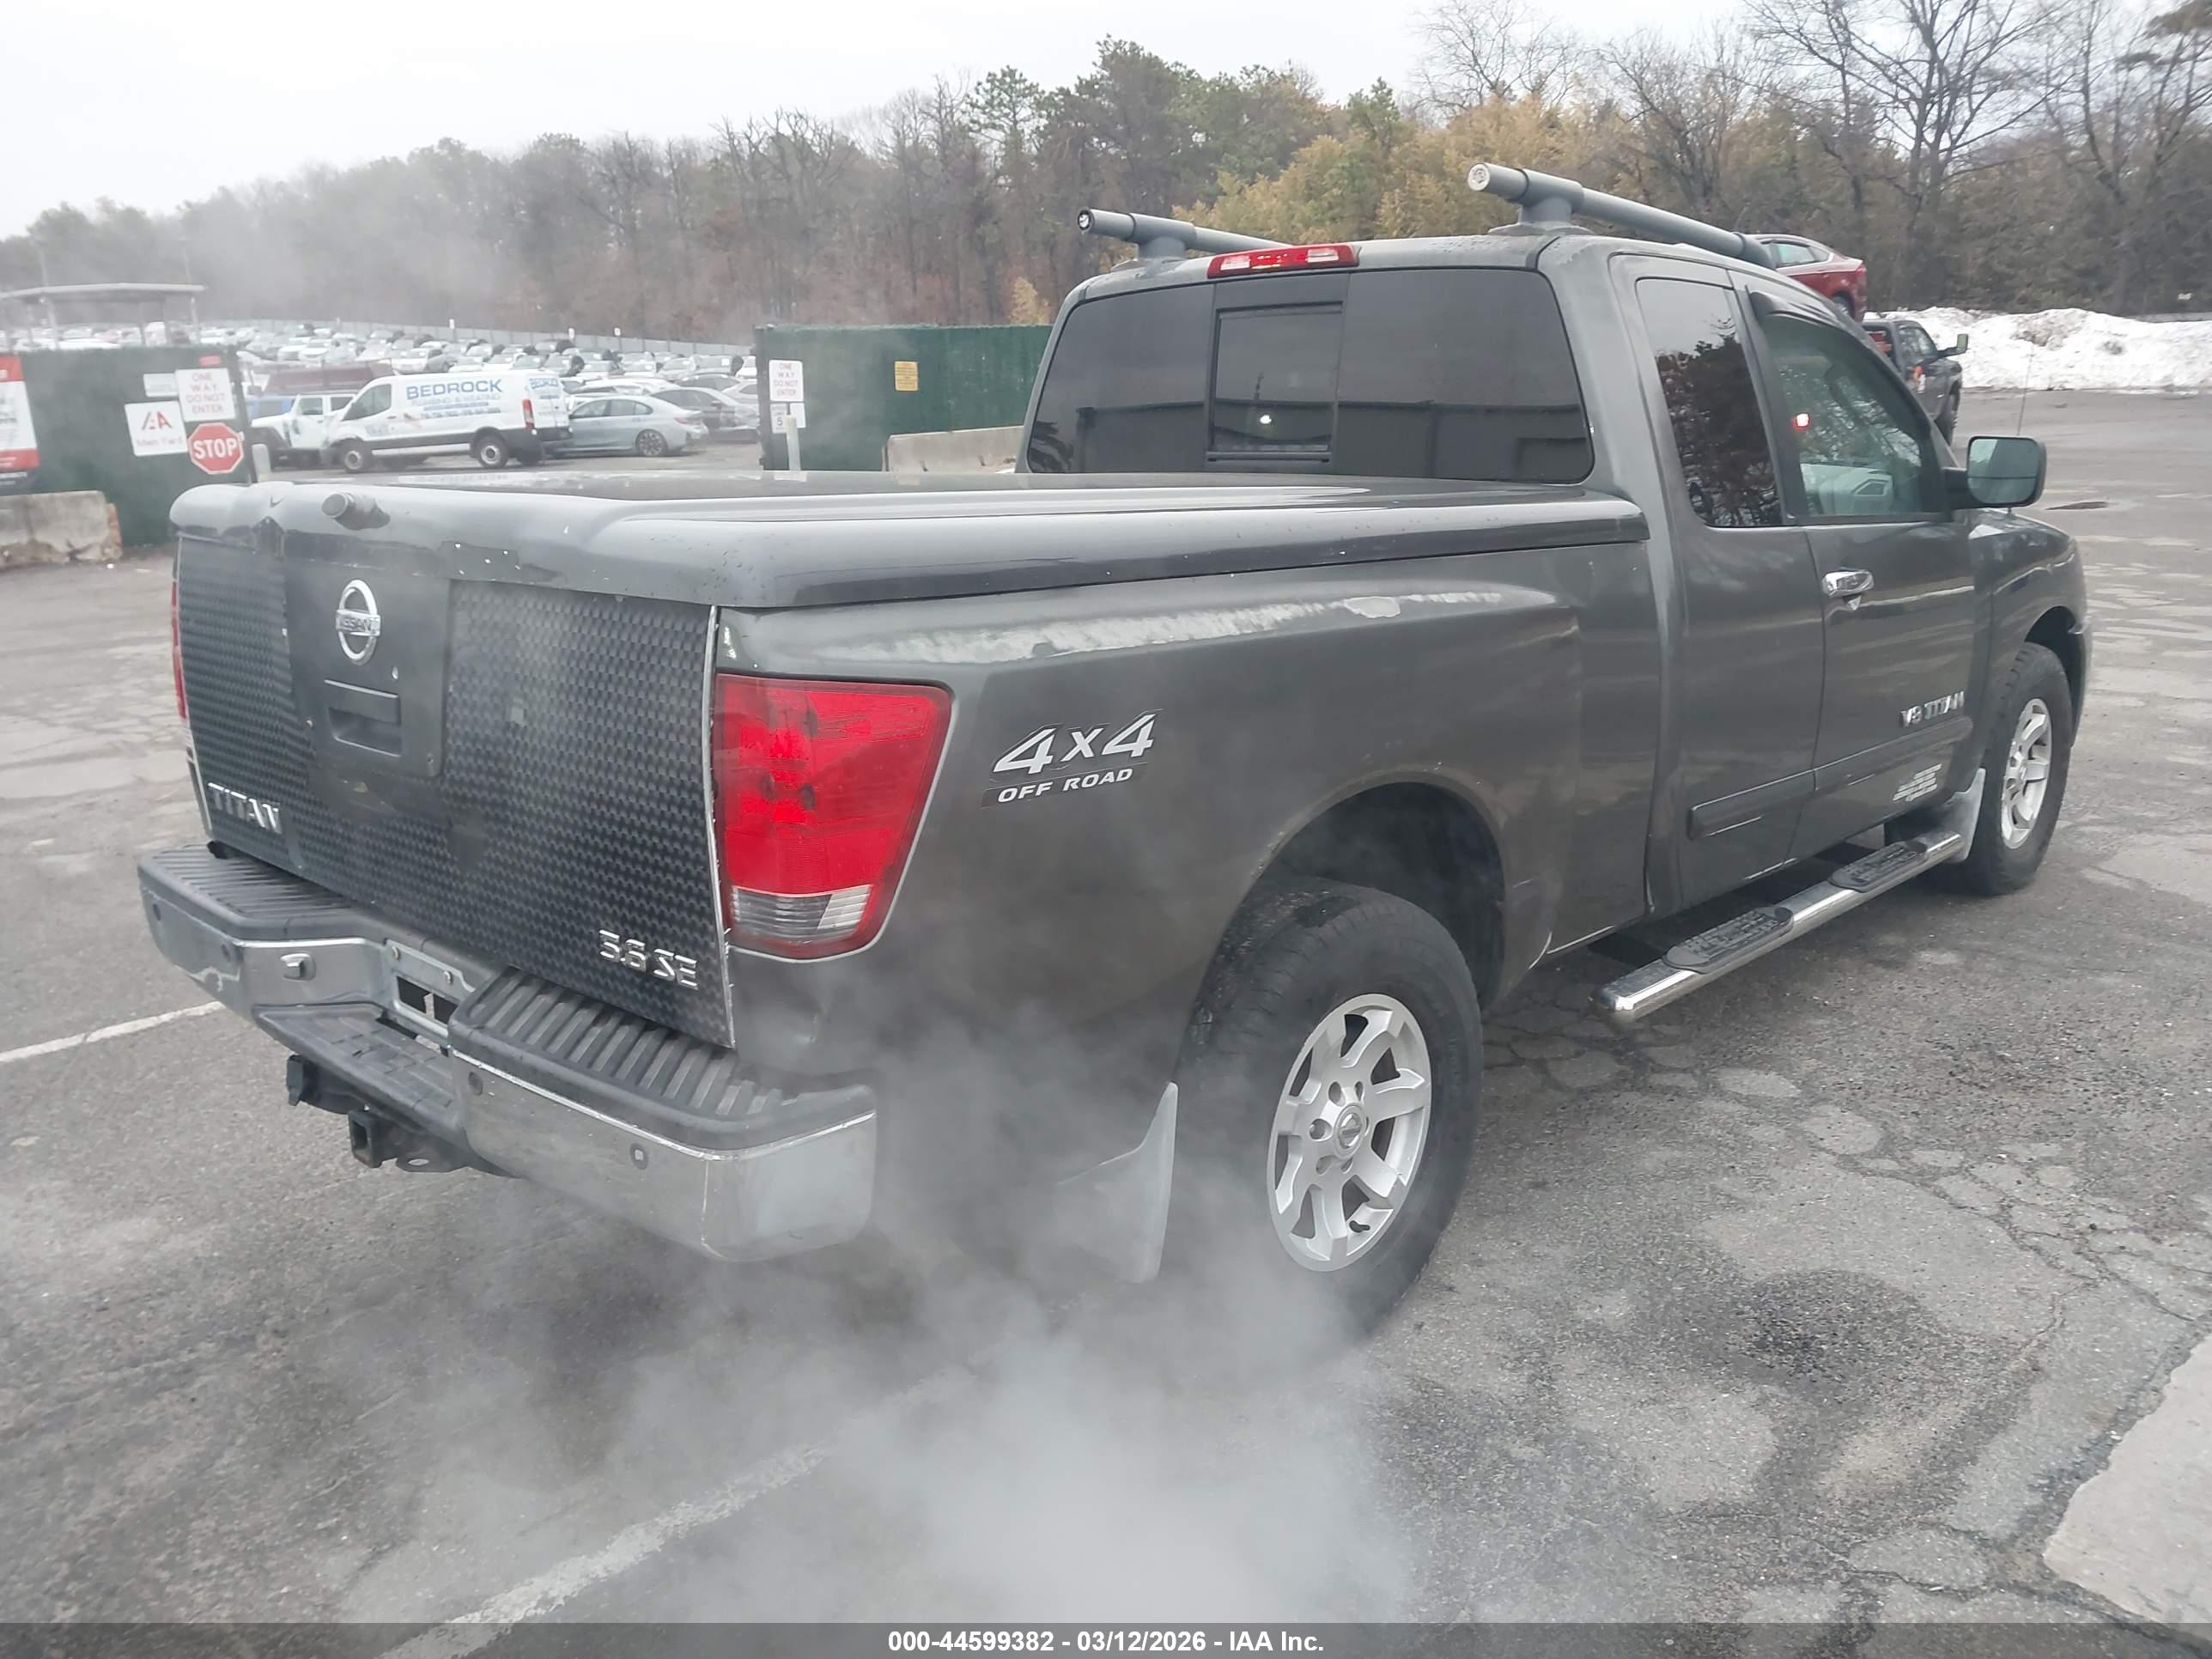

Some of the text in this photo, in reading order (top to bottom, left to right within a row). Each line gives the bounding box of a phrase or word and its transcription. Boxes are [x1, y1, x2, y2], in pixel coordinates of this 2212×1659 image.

[192, 372, 212, 381] ONE
[186, 393, 226, 404] DO NOT
[191, 384, 219, 392] WAY
[406, 379, 502, 401] BEDROCK
[191, 404, 223, 414] ENTER
[193, 437, 238, 459] STOP
[998, 768, 1133, 803] OFF ROAD
[208, 782, 283, 834] TITAN
[599, 929, 699, 991] 5.6 SE
